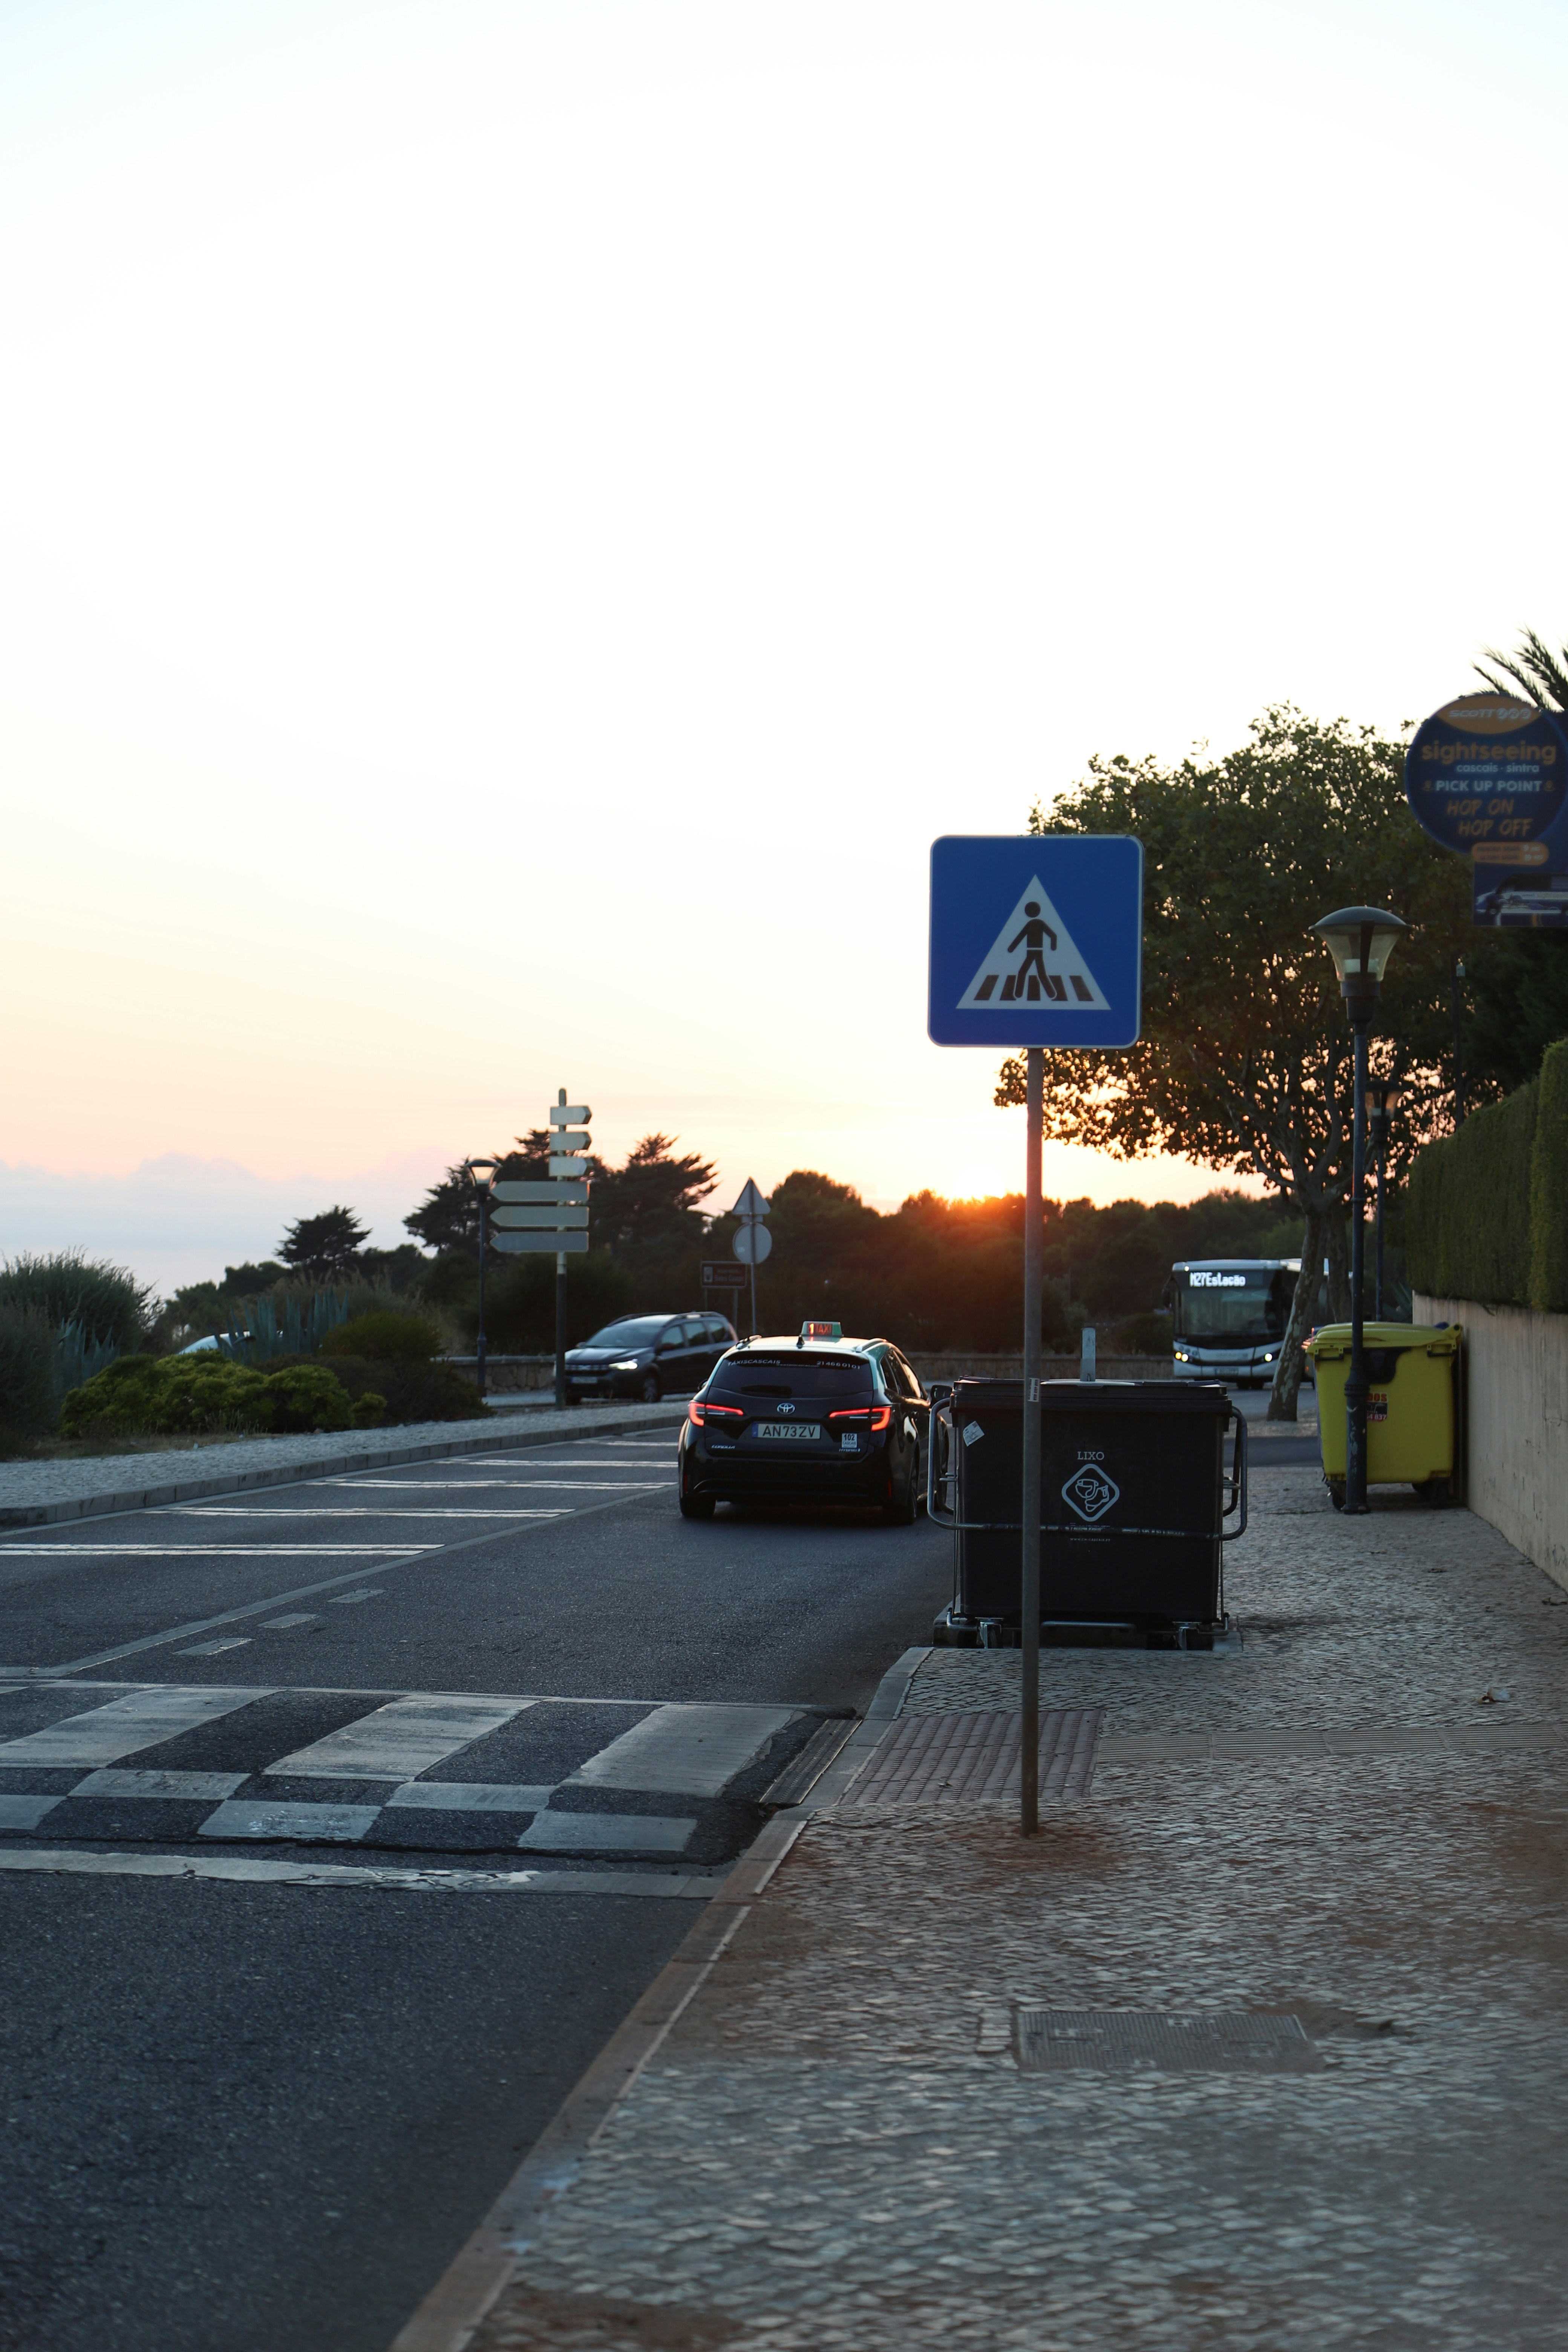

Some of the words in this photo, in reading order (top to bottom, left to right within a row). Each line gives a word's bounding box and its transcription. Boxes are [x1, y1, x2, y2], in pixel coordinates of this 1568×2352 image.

[1422, 740, 1556, 765] sightseeing
[1456, 762, 1498, 773] cascais
[1506, 763, 1539, 773] sintra
[1436, 780, 1468, 791] PICK
[1474, 780, 1493, 791] UP
[1497, 780, 1542, 792] POINT
[1447, 799, 1481, 816] HOP
[1488, 799, 1514, 815] ON
[1458, 819, 1494, 836] HOP
[1500, 818, 1533, 836] OFF
[809, 1323, 815, 1335] 1
[815, 1323, 831, 1335] TAXI
[1077, 1451, 1104, 1461] LIXO
